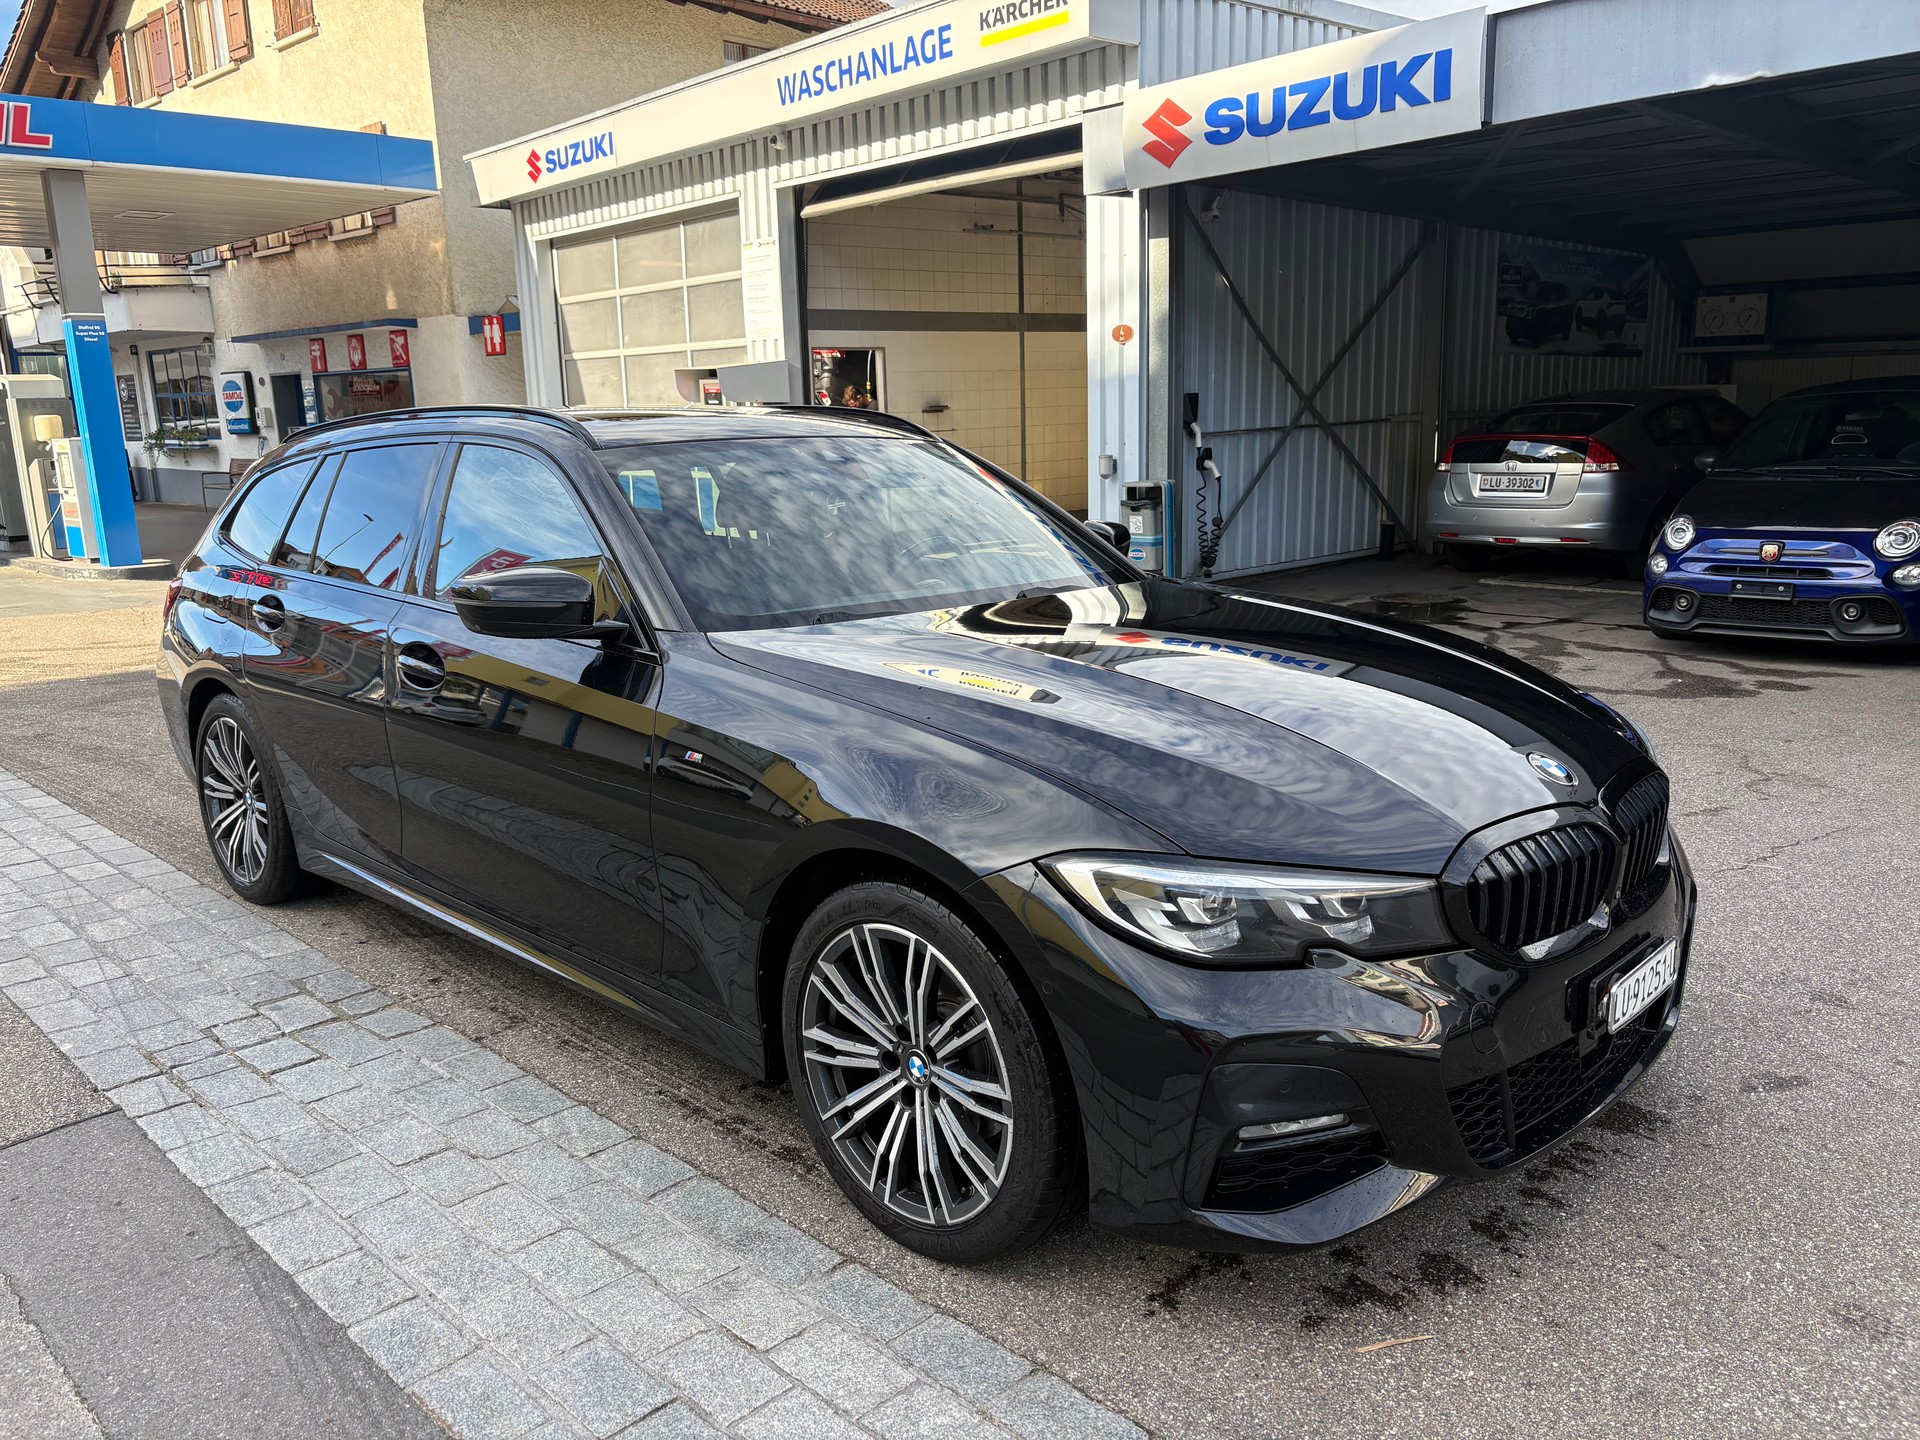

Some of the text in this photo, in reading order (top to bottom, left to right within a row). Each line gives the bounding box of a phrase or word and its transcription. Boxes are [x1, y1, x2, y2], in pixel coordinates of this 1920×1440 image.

[776, 23, 953, 106] WASCHANLAGE
[1203, 47, 1453, 146] SUZUKI
[545, 131, 614, 174] SUZUKI
